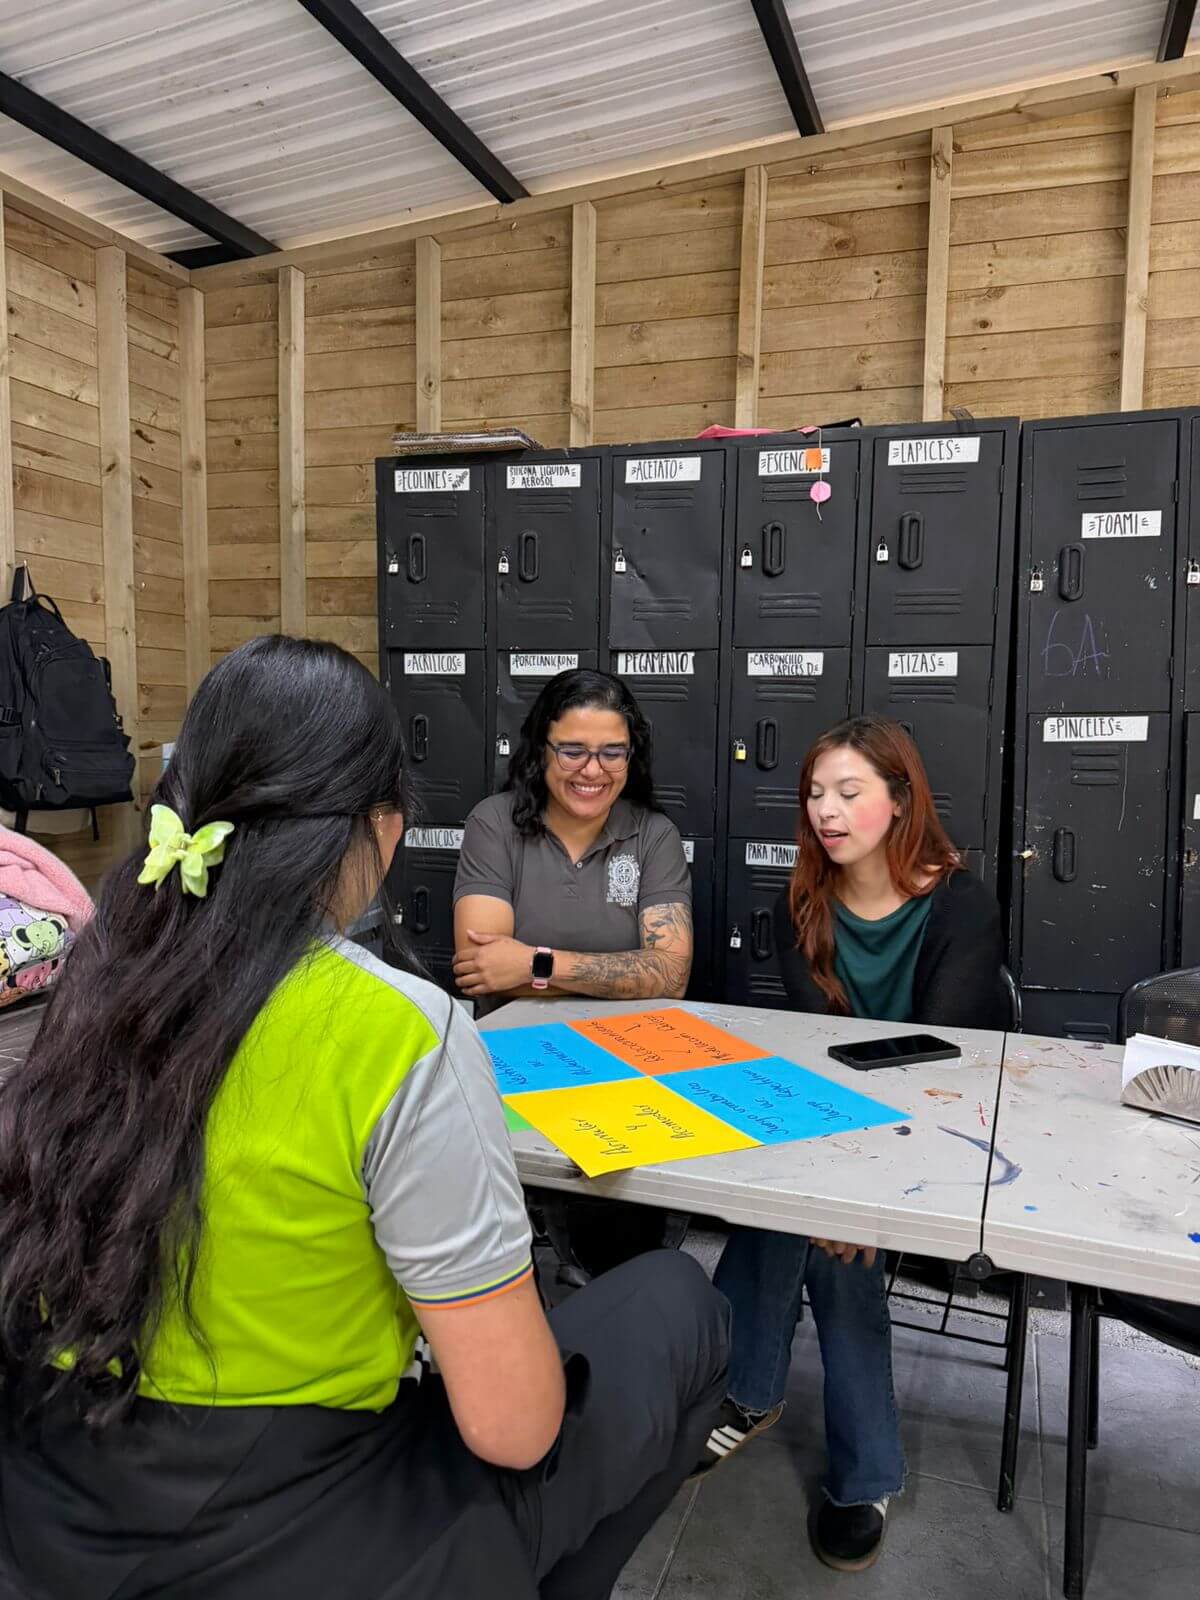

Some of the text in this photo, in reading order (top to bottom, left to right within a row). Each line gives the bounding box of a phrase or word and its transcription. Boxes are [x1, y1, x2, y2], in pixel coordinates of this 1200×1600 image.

[767, 450, 821, 473] ESCENC
[901, 439, 954, 463] LAPICES
[402, 470, 447, 490] ECOLINES
[540, 465, 570, 477] LIQUIDA
[636, 459, 678, 481] ACETATO
[1094, 513, 1138, 536] FOAMI
[897, 653, 937, 674] TIZAS
[1056, 717, 1114, 739] PINCELES
[748, 844, 768, 860] PARA
